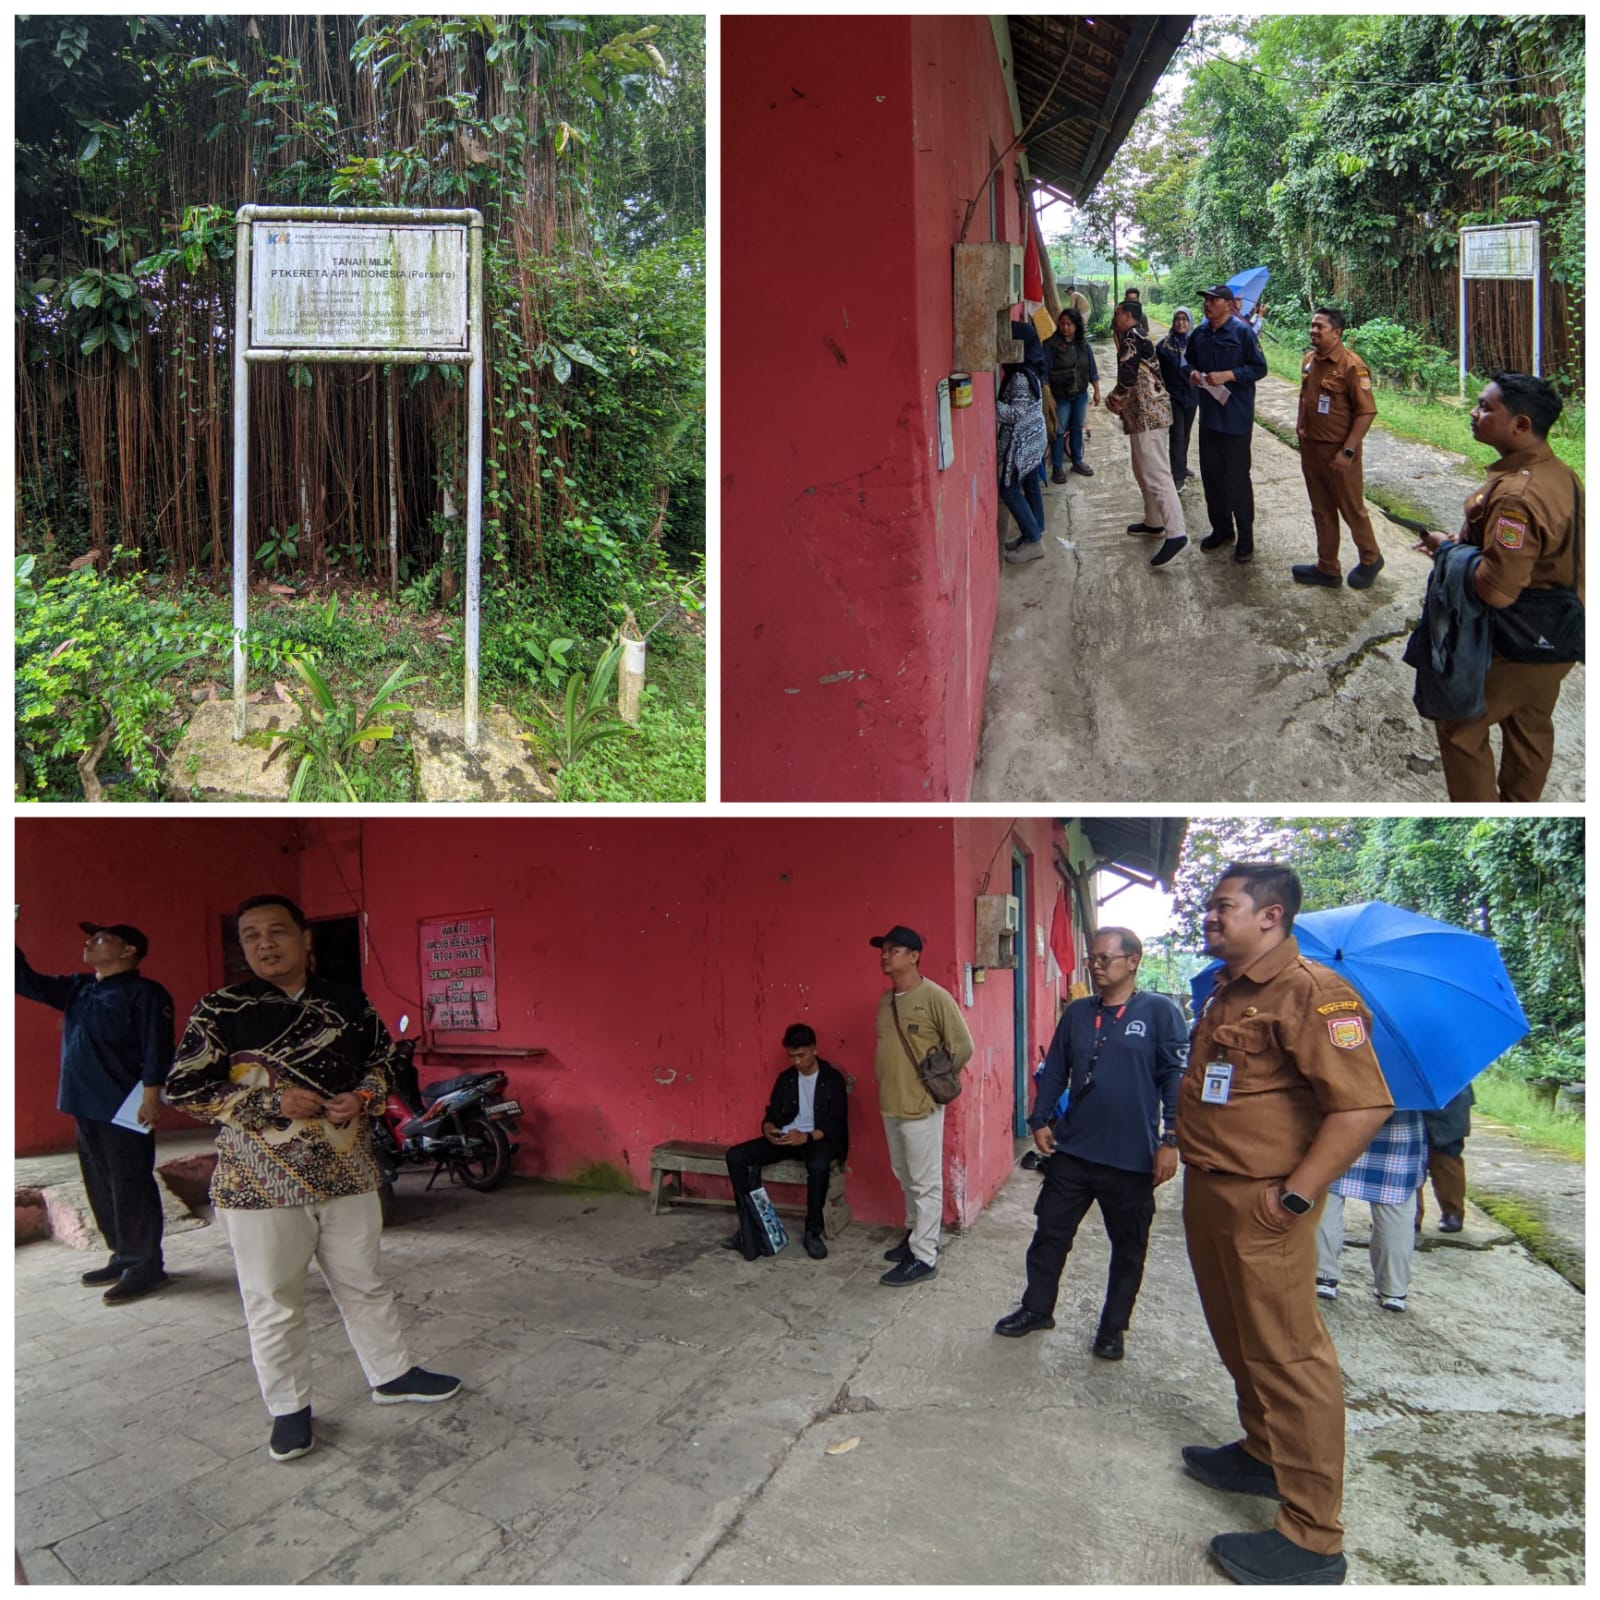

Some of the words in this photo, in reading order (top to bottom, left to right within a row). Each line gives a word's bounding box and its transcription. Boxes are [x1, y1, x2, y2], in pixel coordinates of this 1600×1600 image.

[332, 257, 366, 266] TANAH
[368, 257, 393, 266] MILIK
[330, 269, 348, 278] API
[350, 270, 406, 279] INDONESIA
[441, 925, 469, 935] WAKTU
[426, 940, 449, 949] WAJIB
[450, 936, 487, 947] BELAJAR
[430, 970, 451, 979] SENIN
[456, 968, 482, 977] SABTU
[448, 980, 464, 991] JAM
